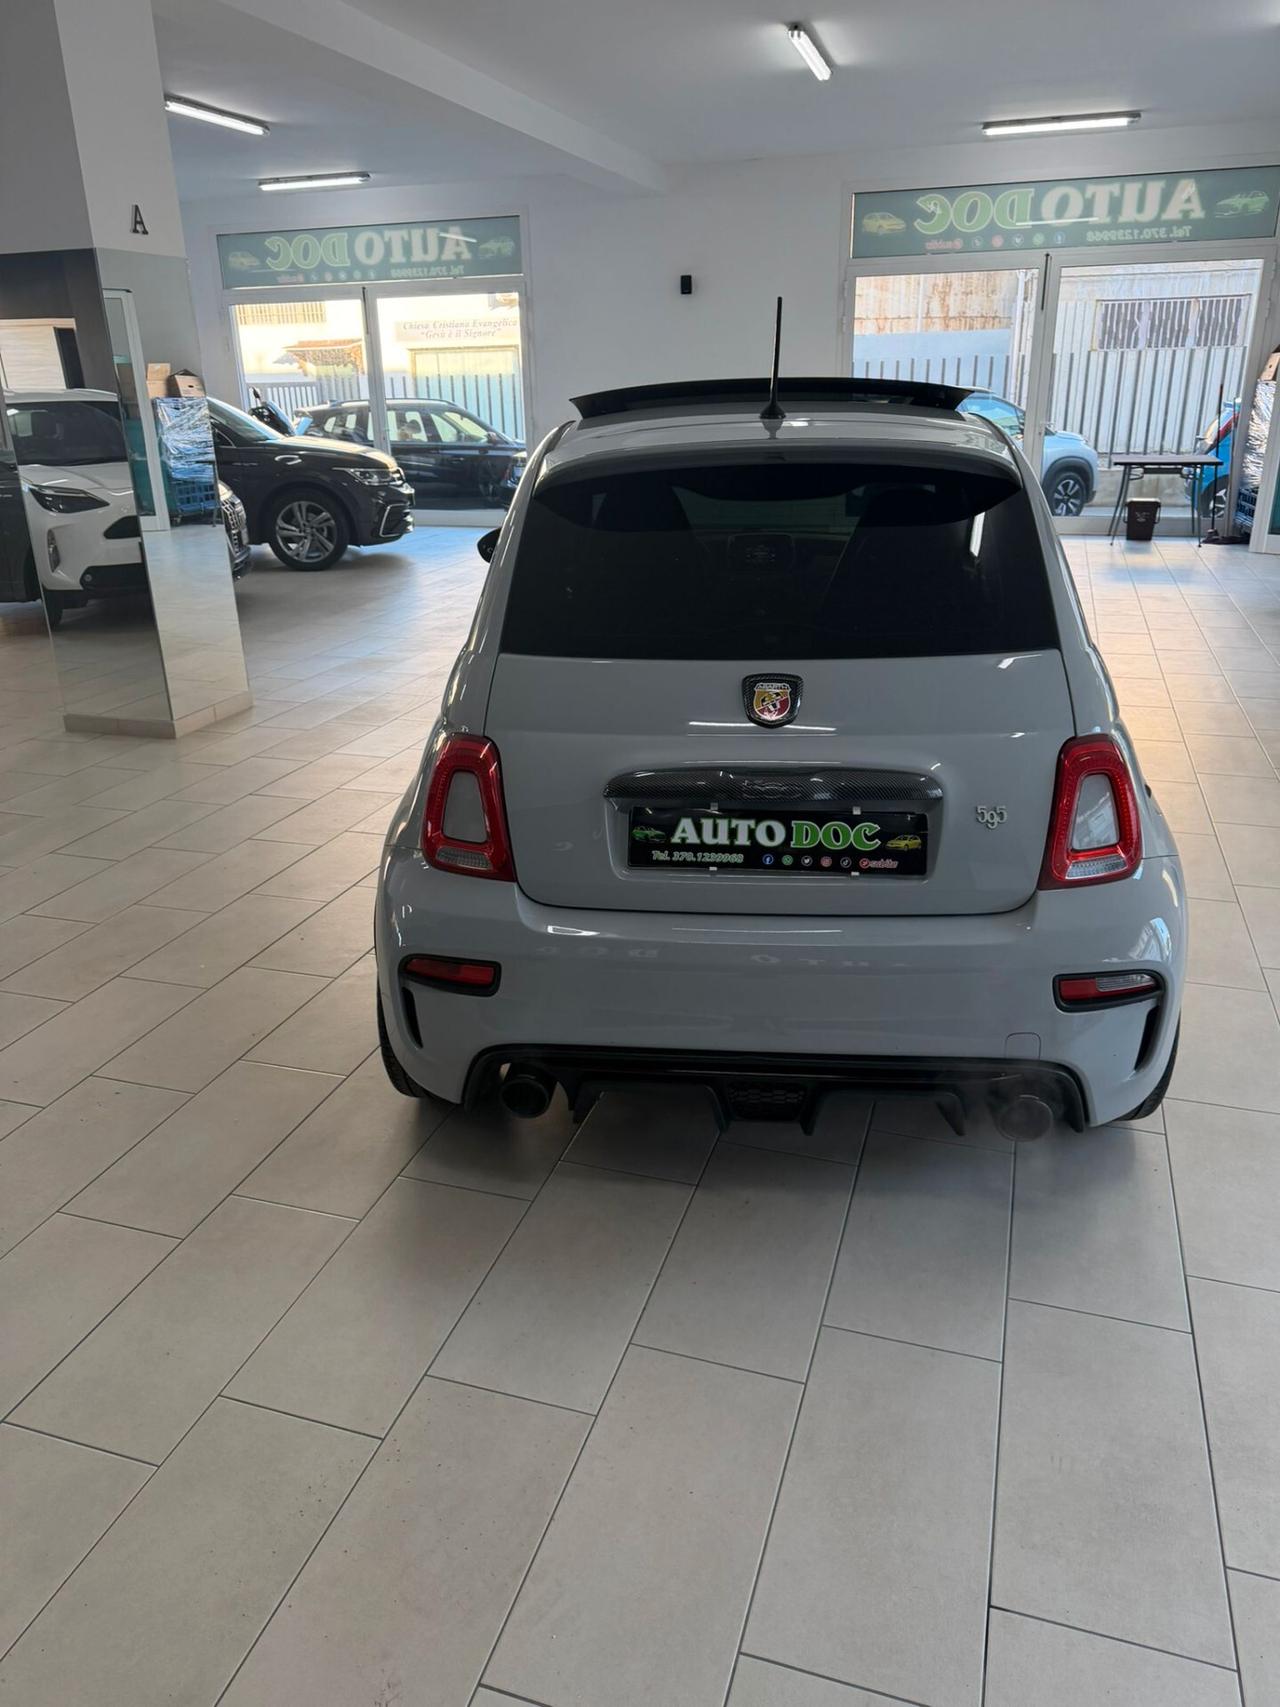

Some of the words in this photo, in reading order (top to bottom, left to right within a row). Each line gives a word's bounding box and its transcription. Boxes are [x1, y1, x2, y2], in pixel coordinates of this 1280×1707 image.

[130, 204, 149, 235] A
[976, 805, 1008, 829] 595
[670, 817, 786, 847] AUTO
[790, 820, 881, 850] DOC
